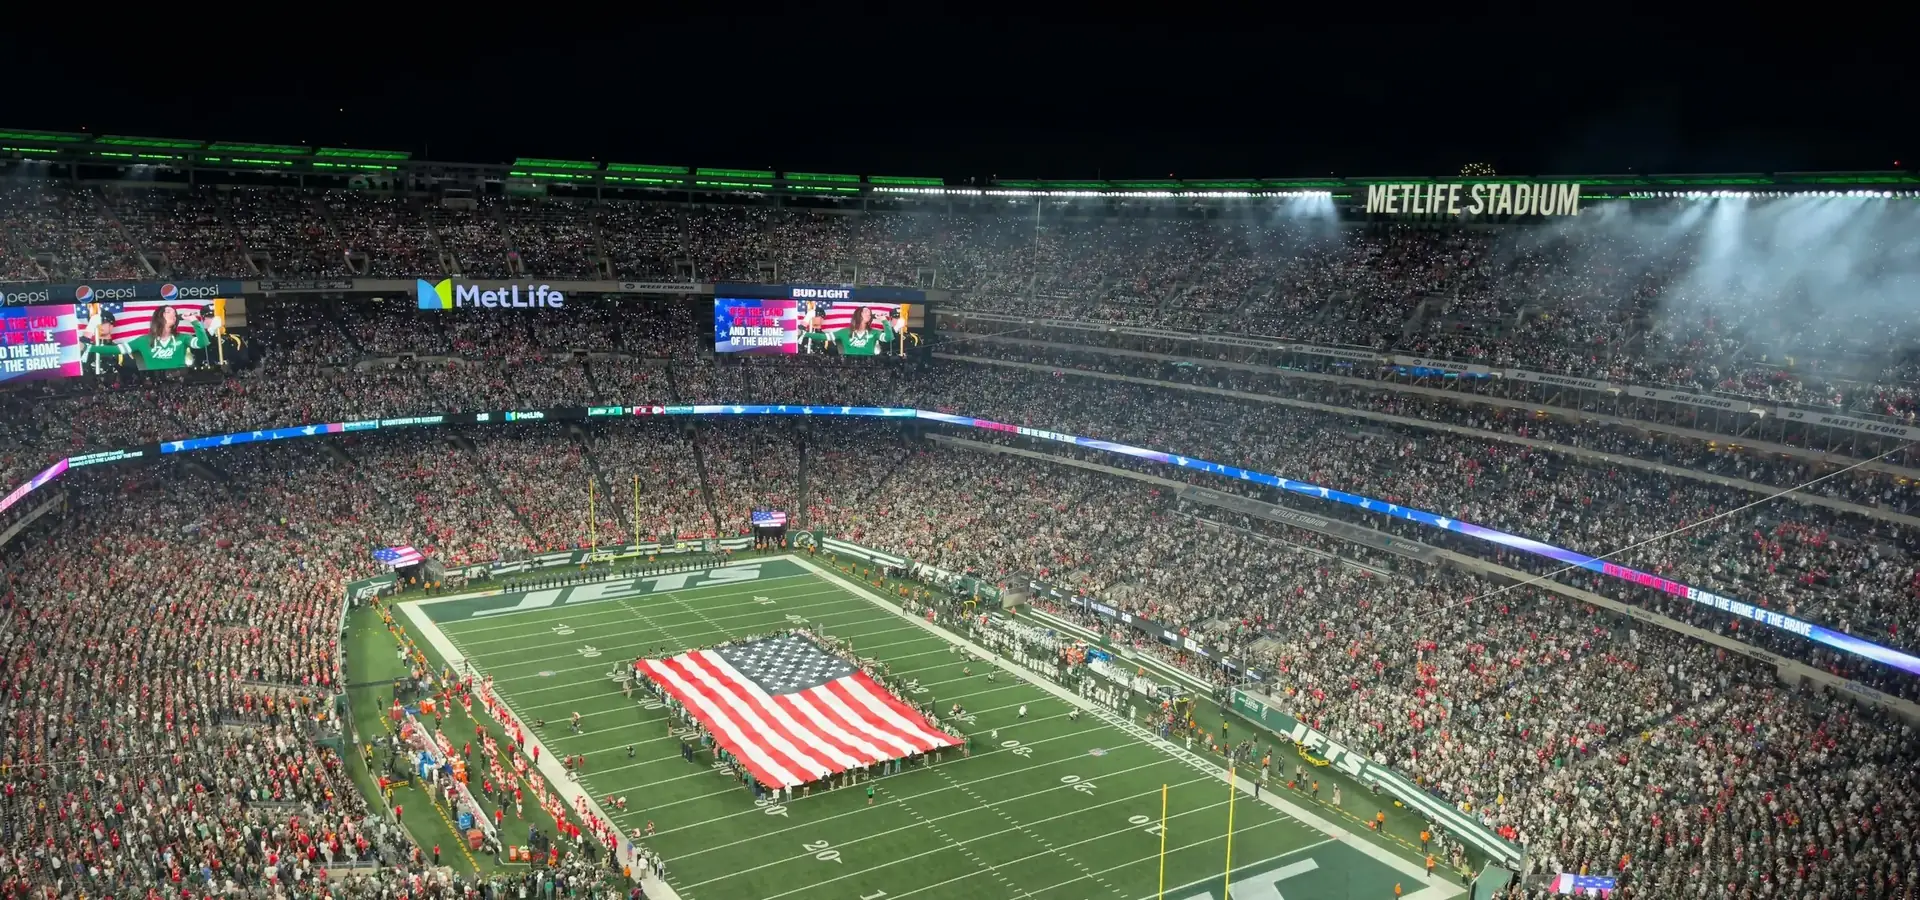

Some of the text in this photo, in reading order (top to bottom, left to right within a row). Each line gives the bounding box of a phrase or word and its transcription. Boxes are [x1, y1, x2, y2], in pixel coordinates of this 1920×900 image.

[1366, 184, 1580, 216] METLIFE STADIUM
[7, 289, 50, 306] pepsi
[95, 286, 136, 302] pepsi
[179, 284, 219, 298] pepsi
[456, 285, 564, 308] MetLife
[793, 288, 850, 299] BUD LIGHT
[729, 327, 784, 337] AND THE HOME
[731, 337, 782, 346] OF THE BRAVE
[8, 345, 31, 359] THE
[31, 342, 62, 357] HOME
[4, 359, 25, 373] THE
[26, 356, 62, 371] BRAVE
[1538, 375, 1577, 385] WINSTON
[1671, 394, 1690, 402] JOE
[381, 418, 413, 426] COUNTDOWN
[516, 411, 544, 419] MetLife
[1820, 416, 1865, 429] MARTY
[1866, 423, 1908, 436] LYONS
[1270, 508, 1329, 528] METLIFE STADIUM
[1394, 542, 1420, 553] MetLife
[472, 563, 762, 617] JETS
[1664, 579, 1679, 594] THE
[1678, 584, 1698, 600] FREE
[1697, 590, 1714, 605] AND
[1714, 595, 1730, 611] THE
[1730, 600, 1755, 618] HOME
[1755, 607, 1766, 621] OF
[1767, 610, 1784, 628] THE
[1783, 617, 1812, 636] BRAVE
[551, 623, 575, 635] 10
[1748, 649, 1776, 663] verizon
[1001, 740, 1033, 755] 30
[1280, 722, 1366, 777] JETS
[1061, 775, 1097, 791] 20
[1128, 814, 1168, 838] 10
[802, 840, 840, 861] 20
